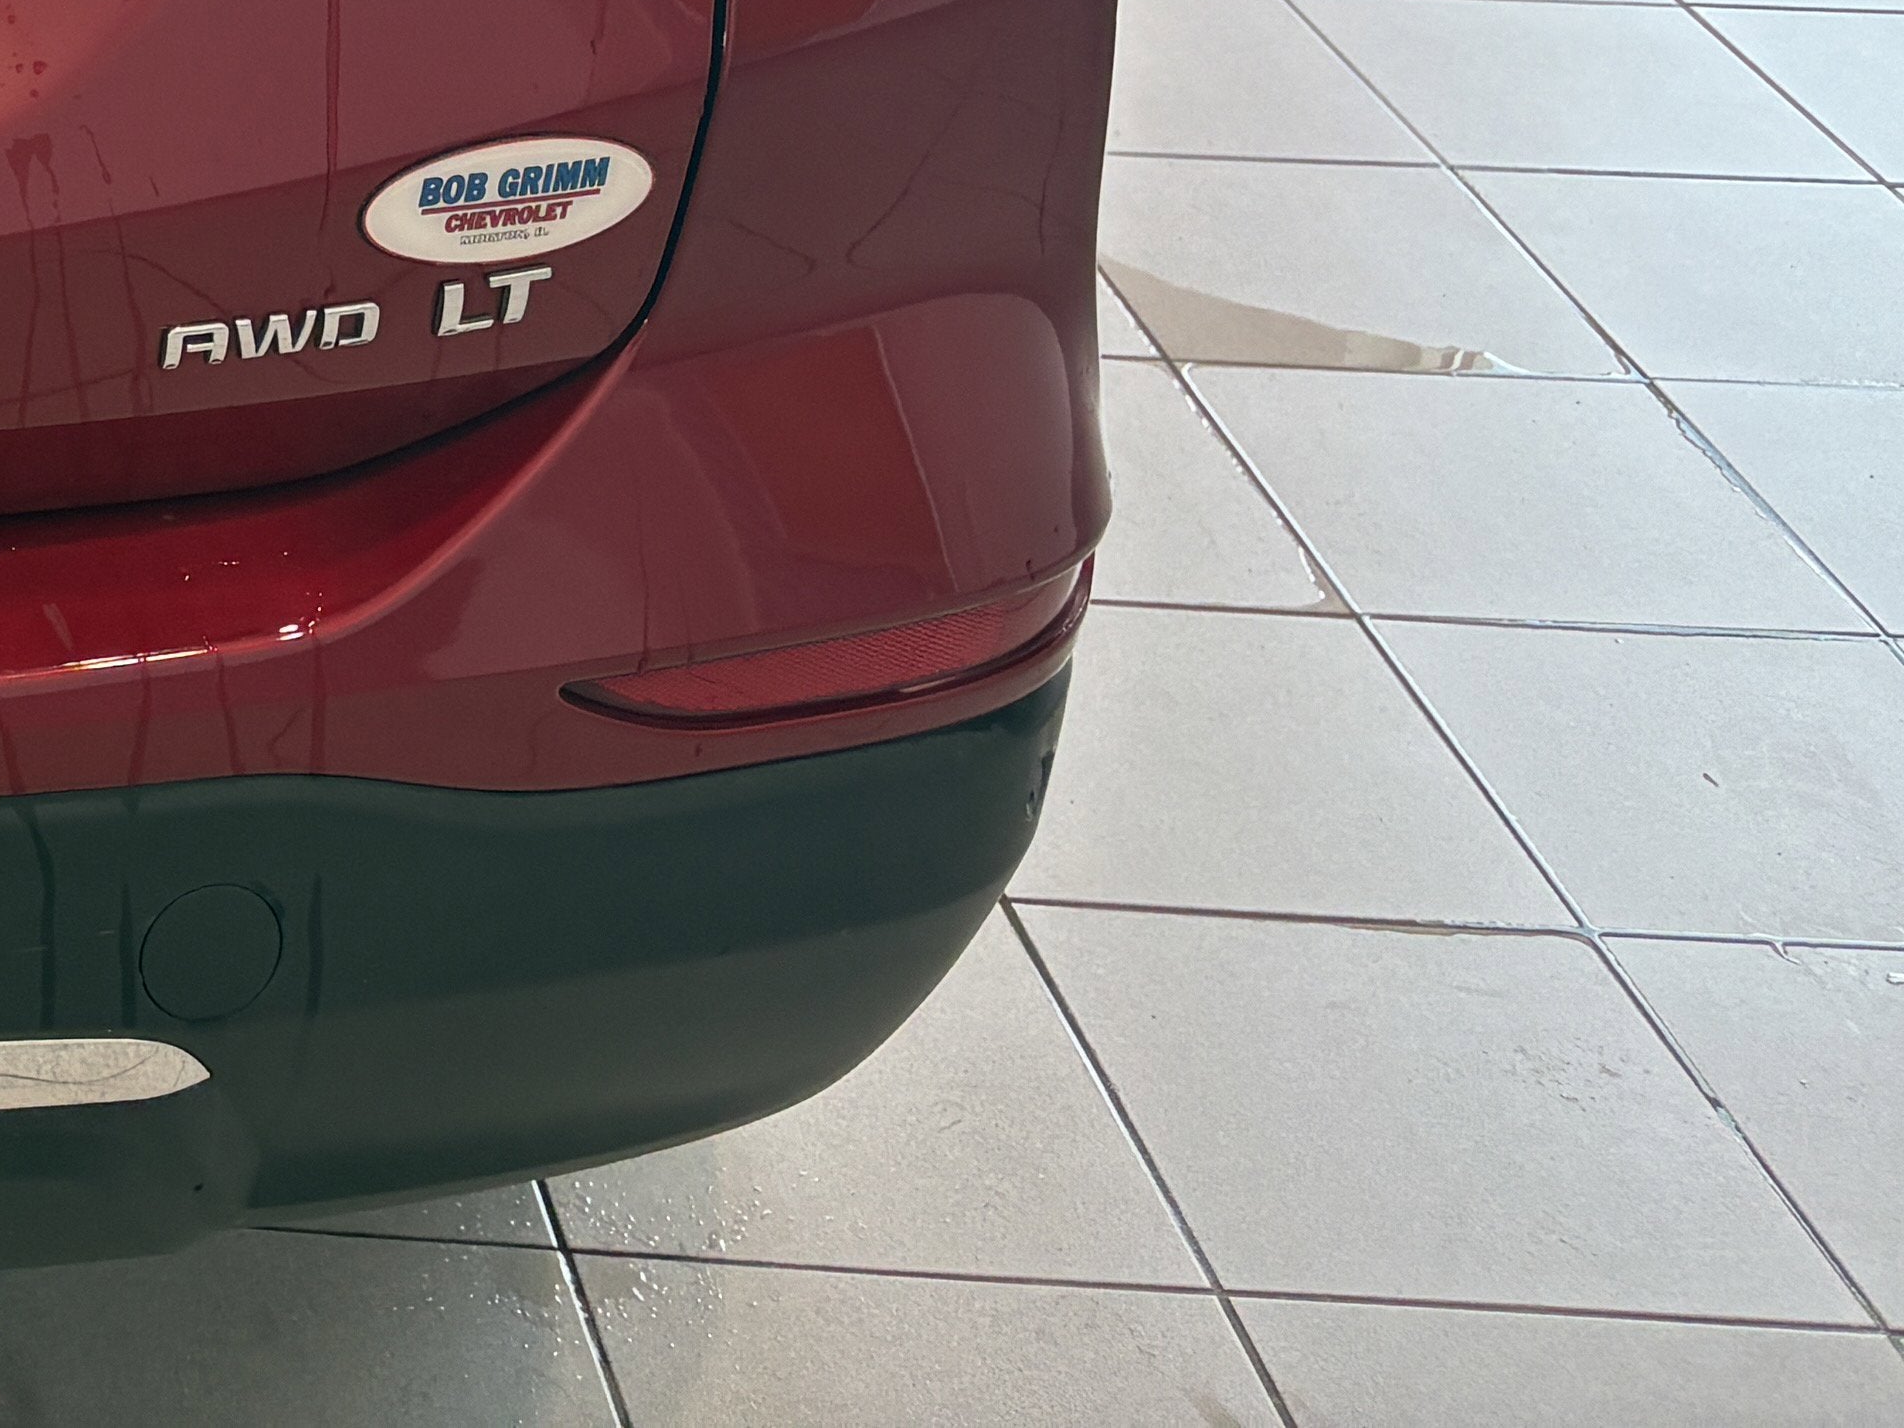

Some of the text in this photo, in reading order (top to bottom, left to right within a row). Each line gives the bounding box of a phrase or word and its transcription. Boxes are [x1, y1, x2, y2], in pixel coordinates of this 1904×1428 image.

[418, 156, 611, 208] BOB GRIMM
[444, 200, 574, 234] CHEVROLET
[161, 266, 553, 370] AWD LT
